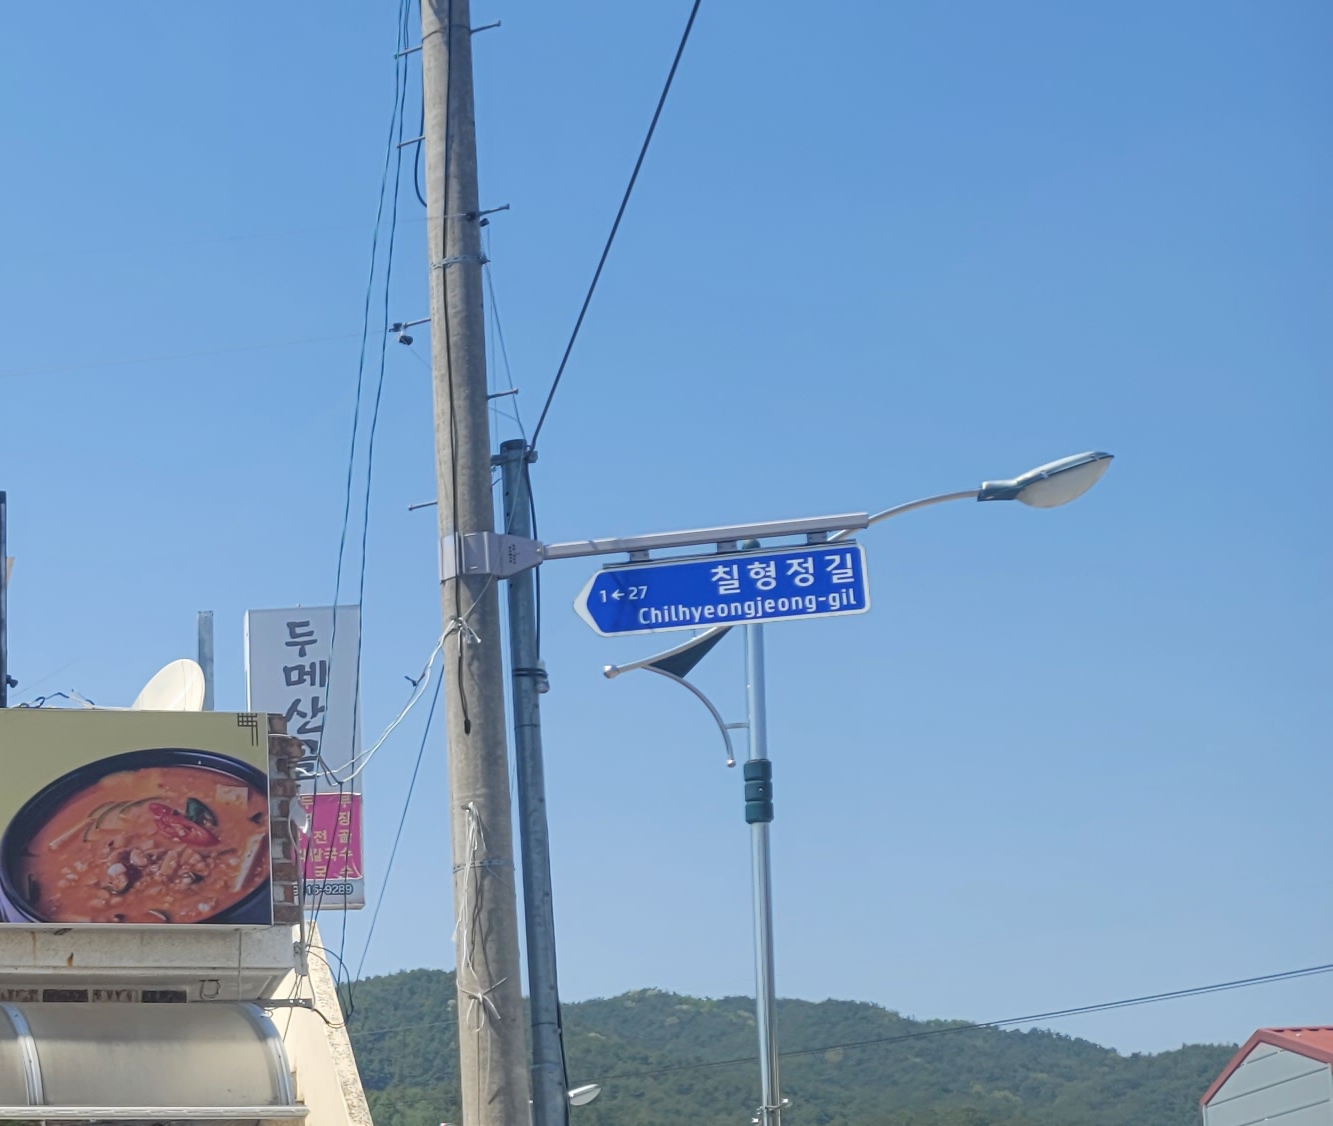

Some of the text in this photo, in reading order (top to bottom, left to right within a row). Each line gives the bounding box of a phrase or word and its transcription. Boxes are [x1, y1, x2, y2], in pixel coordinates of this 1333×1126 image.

[710, 552, 856, 595] 칠형정길
[599, 586, 648, 603] 1 27
[638, 588, 857, 626] Chilhyeongjeong-gil
